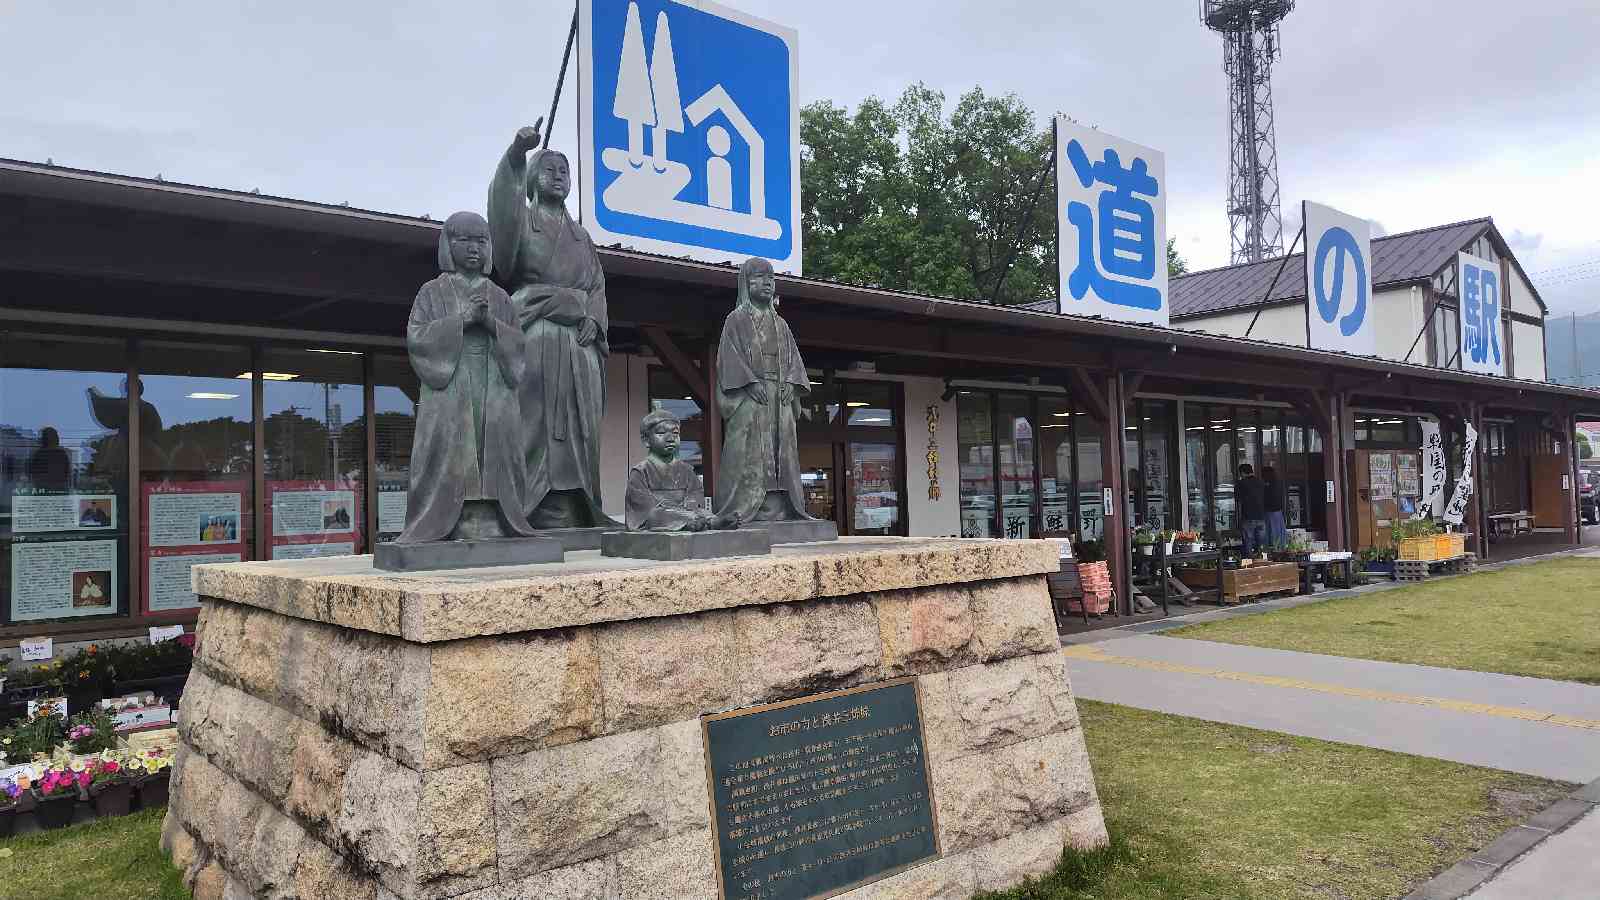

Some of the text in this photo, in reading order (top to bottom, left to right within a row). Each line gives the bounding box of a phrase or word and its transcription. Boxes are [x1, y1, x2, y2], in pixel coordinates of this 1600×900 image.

[1067, 138, 1162, 311] 道
[1314, 226, 1366, 337] の
[1463, 264, 1501, 366] 駅
